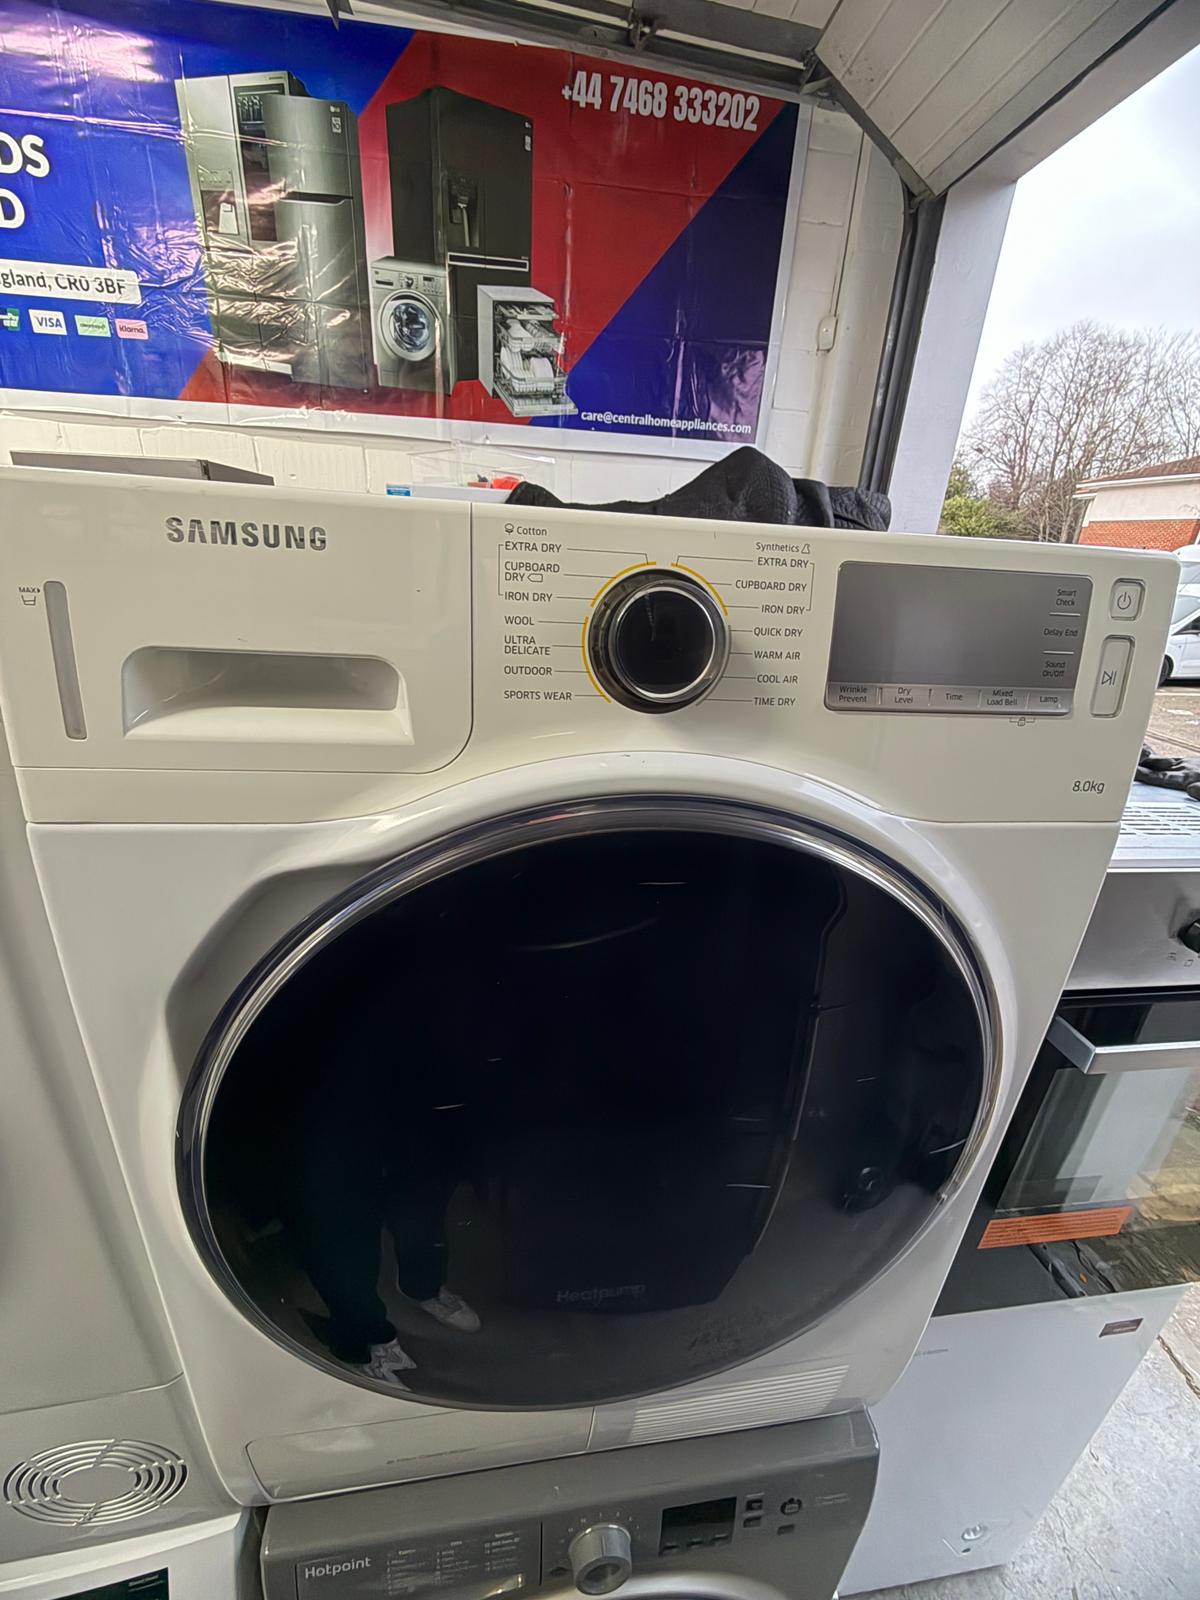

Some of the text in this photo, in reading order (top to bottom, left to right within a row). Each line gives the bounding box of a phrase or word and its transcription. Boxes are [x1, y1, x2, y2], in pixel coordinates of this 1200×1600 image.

[561, 71, 760, 132] +44 7468 333202
[36, 316, 63, 329] VISA
[581, 410, 751, 434] care@centralhomeappliances.com
[165, 517, 327, 551] SAMSUNG
[516, 526, 547, 537] Cotton
[504, 542, 562, 553] EXTRA DRY
[755, 542, 800, 554] Synthetics
[504, 561, 561, 573] CUPBOARD
[757, 557, 809, 569] EXTRA DRY
[504, 572, 526, 582] DRY
[735, 580, 807, 592] CUPBOARD DRY
[504, 592, 553, 602] IRON DRY
[1056, 598, 1075, 606] Check
[761, 604, 806, 615] IRON DRY
[504, 616, 535, 625] WOOL
[753, 627, 803, 638] QUICK DRY
[1043, 628, 1078, 638] Delay End
[504, 635, 536, 645] ULTRA
[504, 645, 551, 656] DELICATE
[753, 651, 800, 661] WARM AIR
[1045, 660, 1066, 668] Sound
[504, 665, 553, 676] OUTDOOR
[1042, 669, 1065, 677] On/Off
[756, 674, 798, 684] COOL AIR
[839, 685, 868, 694] Wrinkle
[897, 687, 911, 696] Dry
[992, 689, 1013, 697] Mixed
[503, 690, 572, 701] SPORTS WEAR
[838, 694, 867, 703] Prevent
[894, 696, 914, 704] Level
[945, 692, 963, 701] Time
[1039, 695, 1058, 704] Lamp
[753, 697, 796, 706] TIME DRY
[986, 698, 1018, 706] Load Bell
[1072, 780, 1105, 795] 8.0kg
[304, 1556, 372, 1579] Hotpoint
